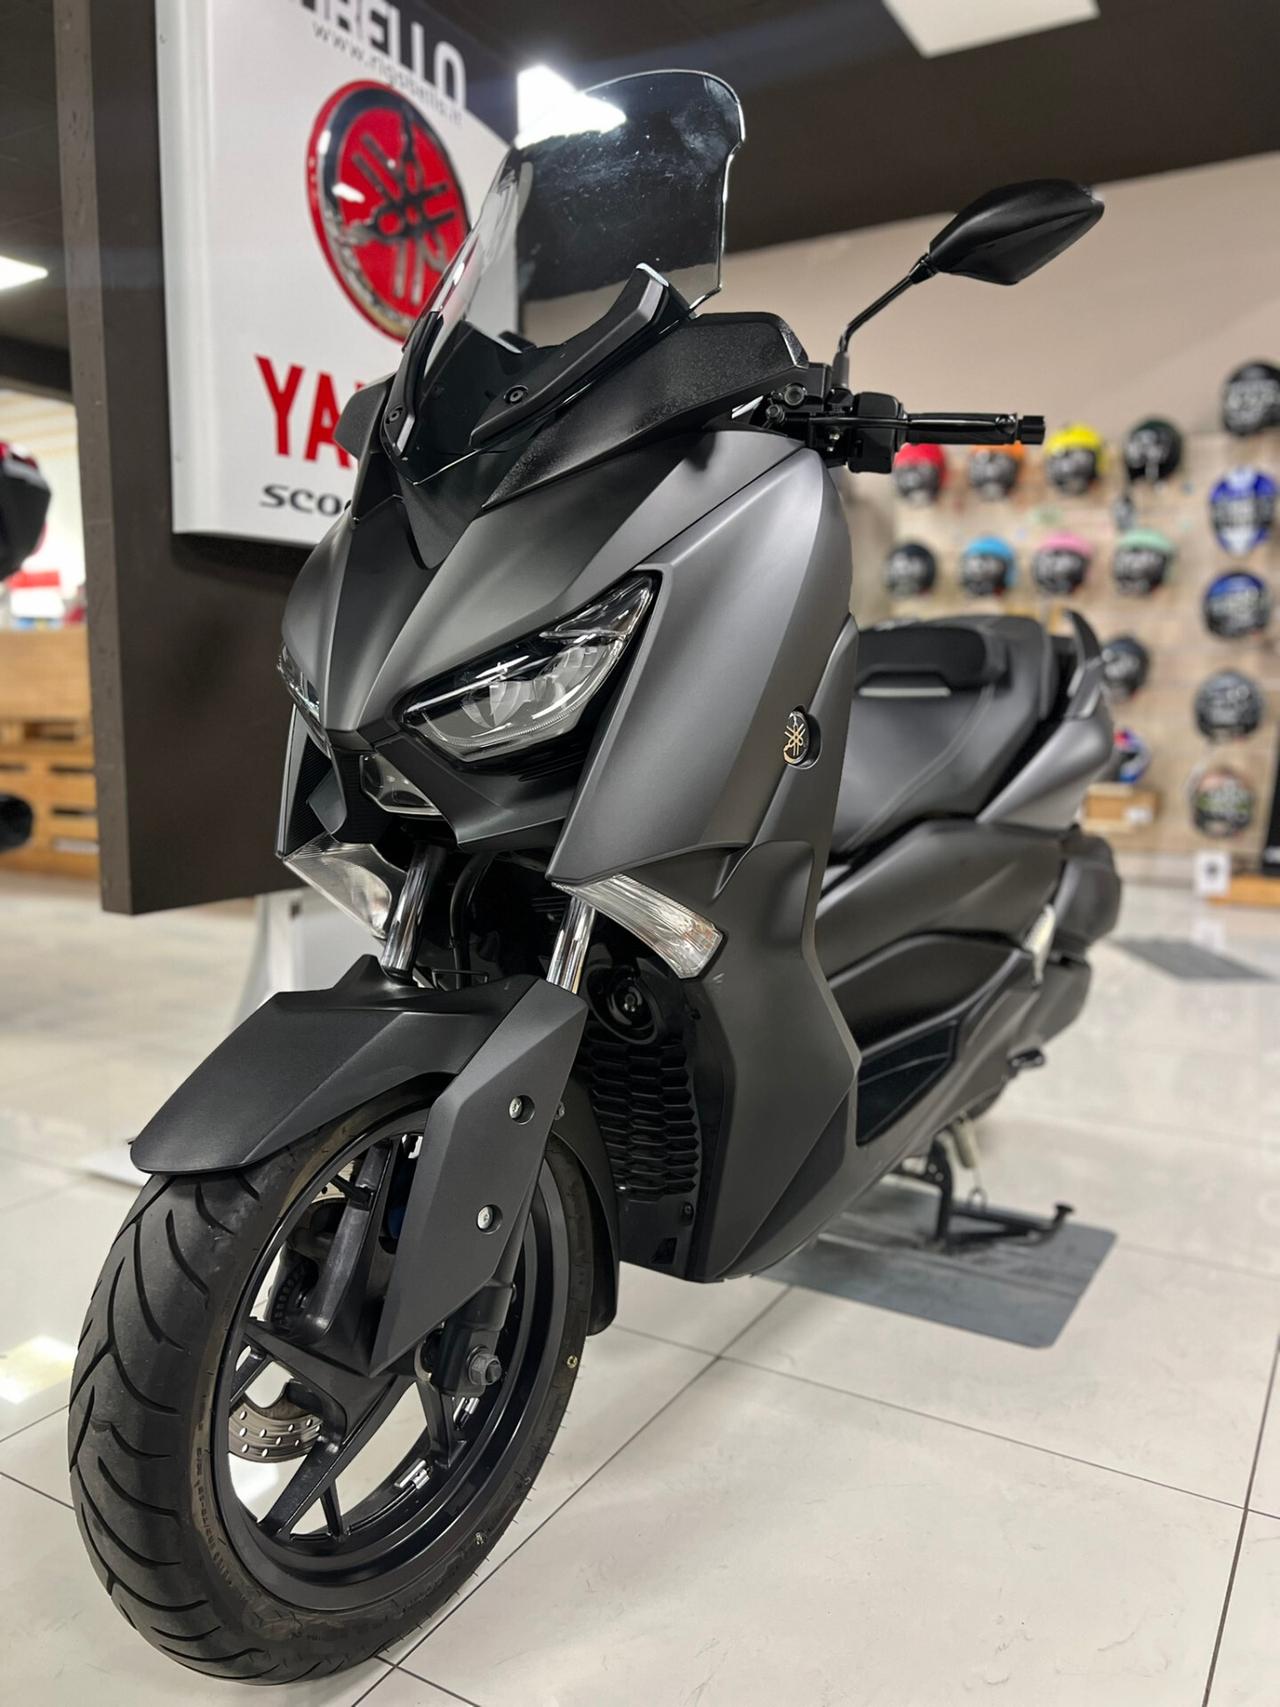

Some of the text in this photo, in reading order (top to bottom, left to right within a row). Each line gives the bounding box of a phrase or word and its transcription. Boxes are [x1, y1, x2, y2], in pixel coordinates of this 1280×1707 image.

[298, 0, 467, 110] BELLO
[254, 353, 365, 470] YA
[259, 483, 352, 518] SCO
